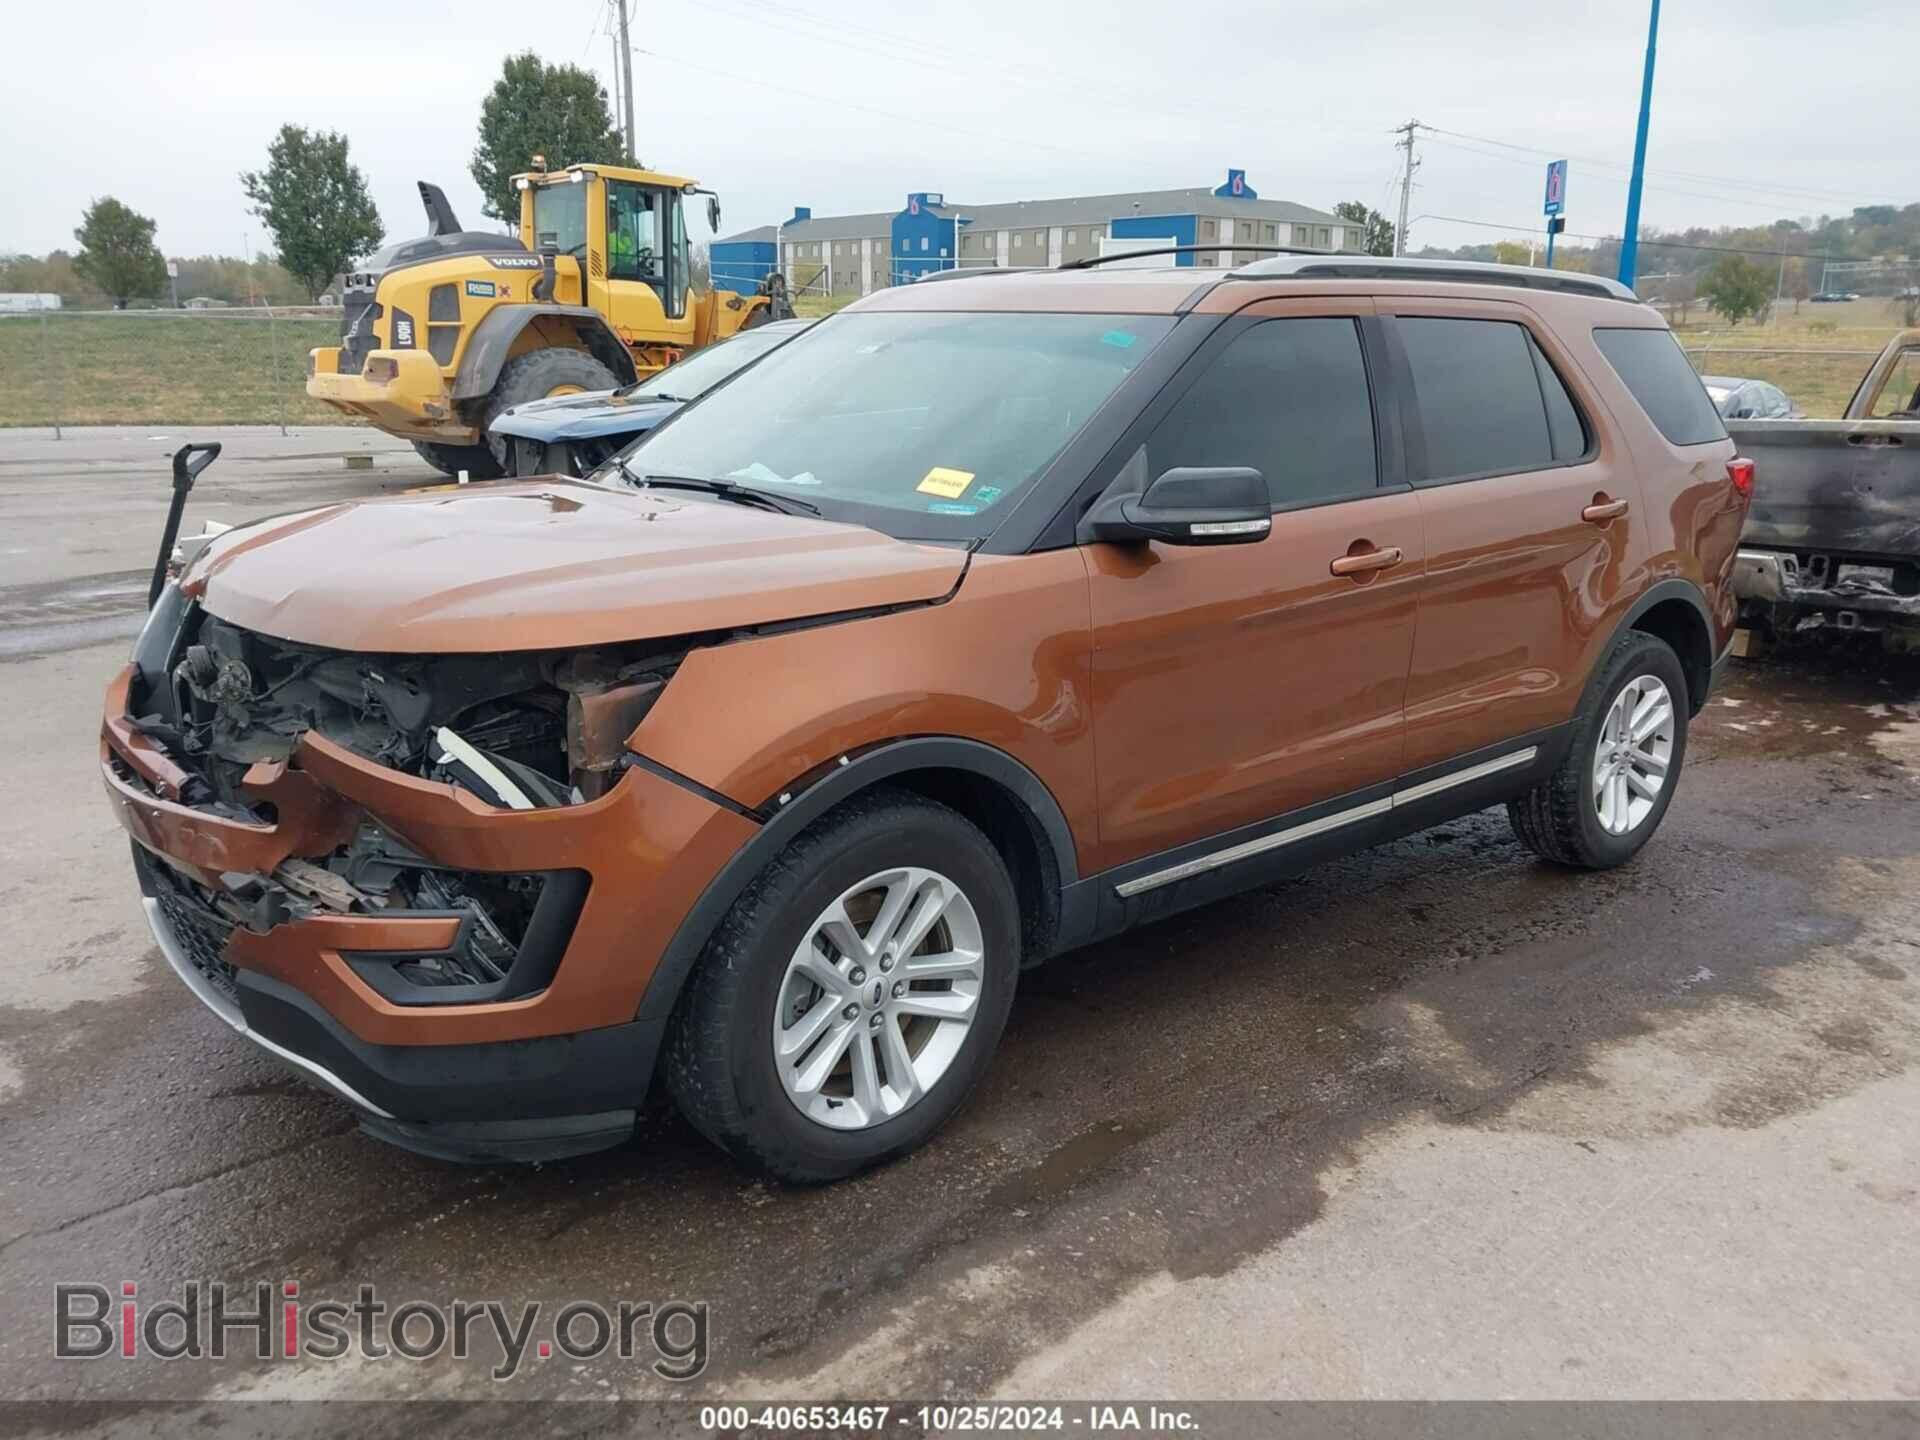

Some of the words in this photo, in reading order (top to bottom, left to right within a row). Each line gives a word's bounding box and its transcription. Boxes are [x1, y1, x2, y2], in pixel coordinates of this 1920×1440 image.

[1232, 174, 1243, 195] 6
[911, 195, 920, 216] 6
[491, 258, 538, 266] VOLVO
[397, 320, 412, 345] L90H
